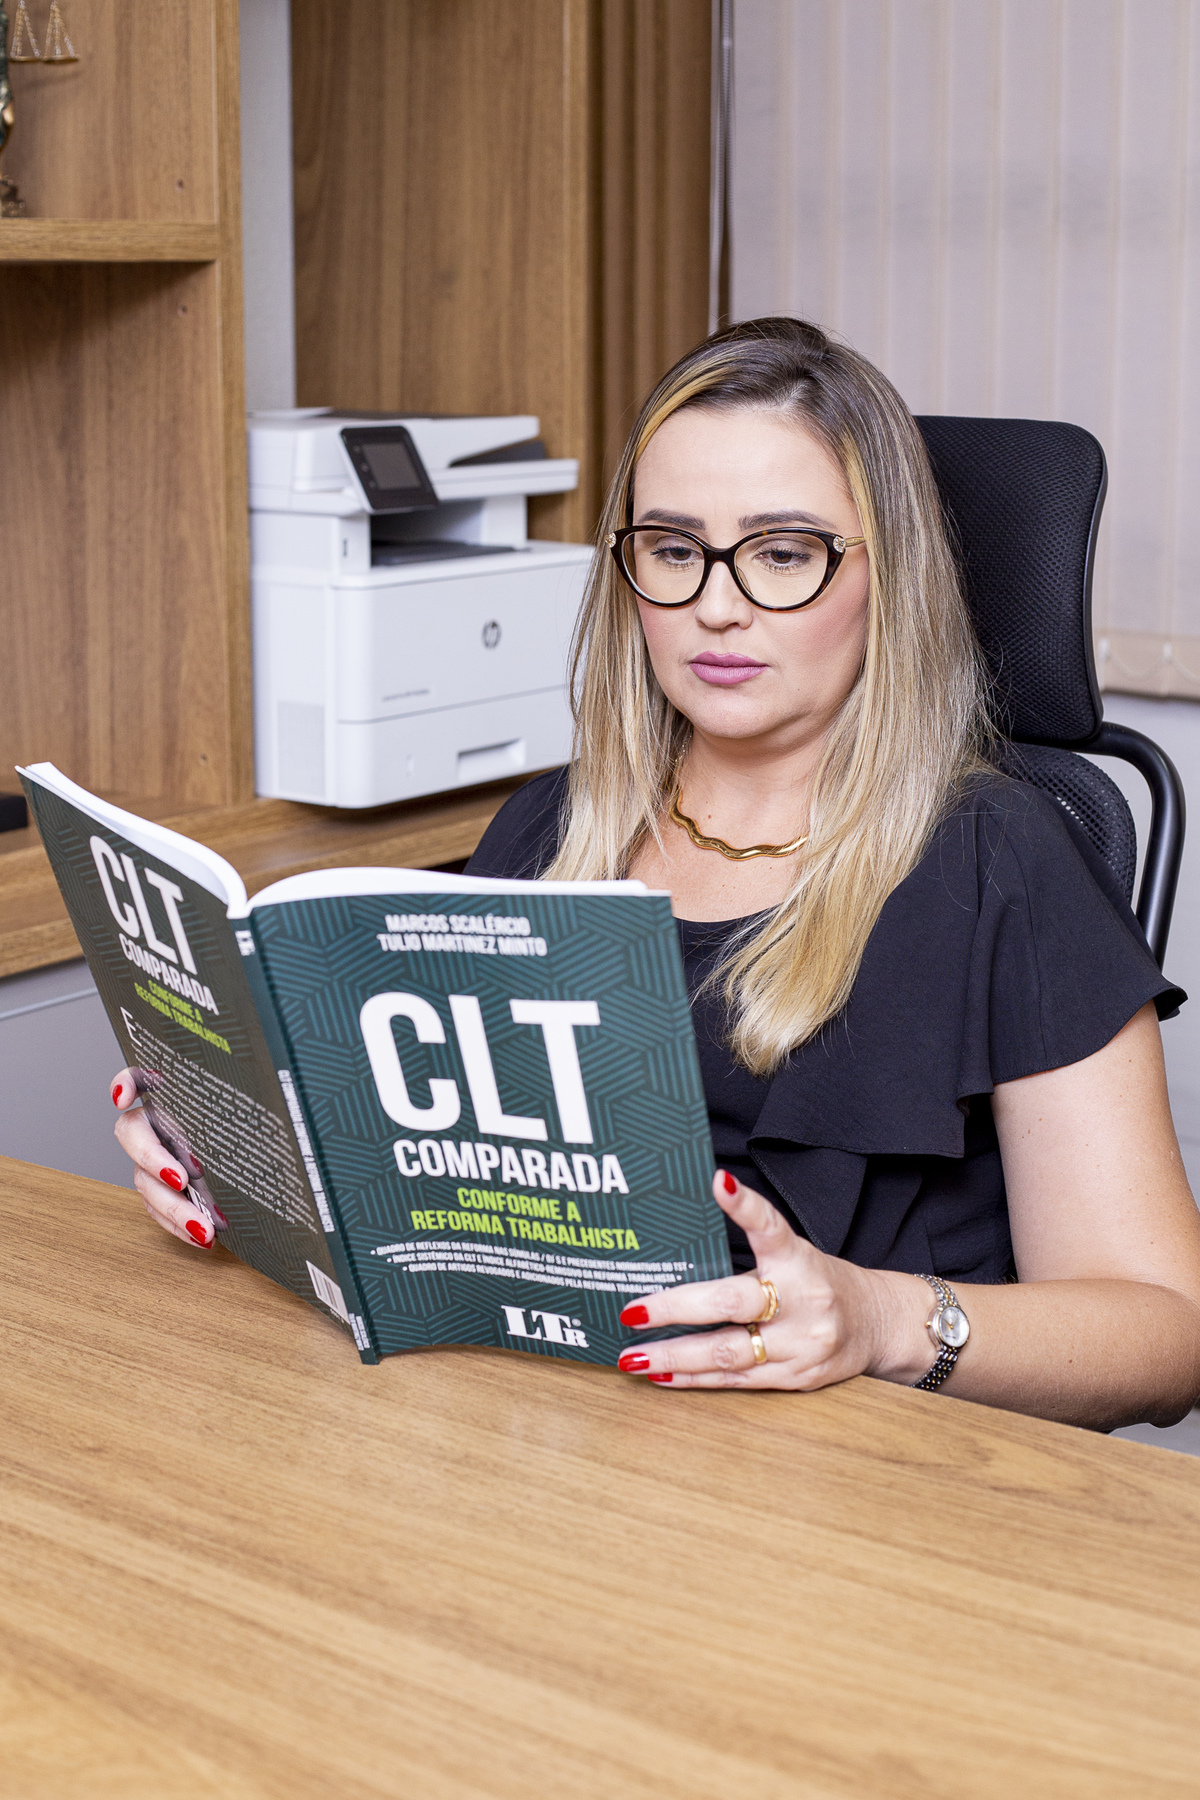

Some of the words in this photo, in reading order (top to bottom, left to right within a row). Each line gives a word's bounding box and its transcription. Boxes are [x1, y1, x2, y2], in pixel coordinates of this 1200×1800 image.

[90, 835, 197, 975] CLT
[384, 914, 449, 934] MARCOS
[376, 933, 422, 952] TULIO
[422, 934, 498, 955] MARTINEZ
[498, 937, 548, 957] MINTO
[118, 933, 220, 1016] COMPARADA
[358, 991, 601, 1144] CLT
[393, 1138, 630, 1194] COMPARADA
[457, 1187, 562, 1222] CONFORME
[567, 1201, 582, 1223] A
[411, 1210, 505, 1237] REFORMA
[506, 1216, 640, 1251] TRABALHISTA
